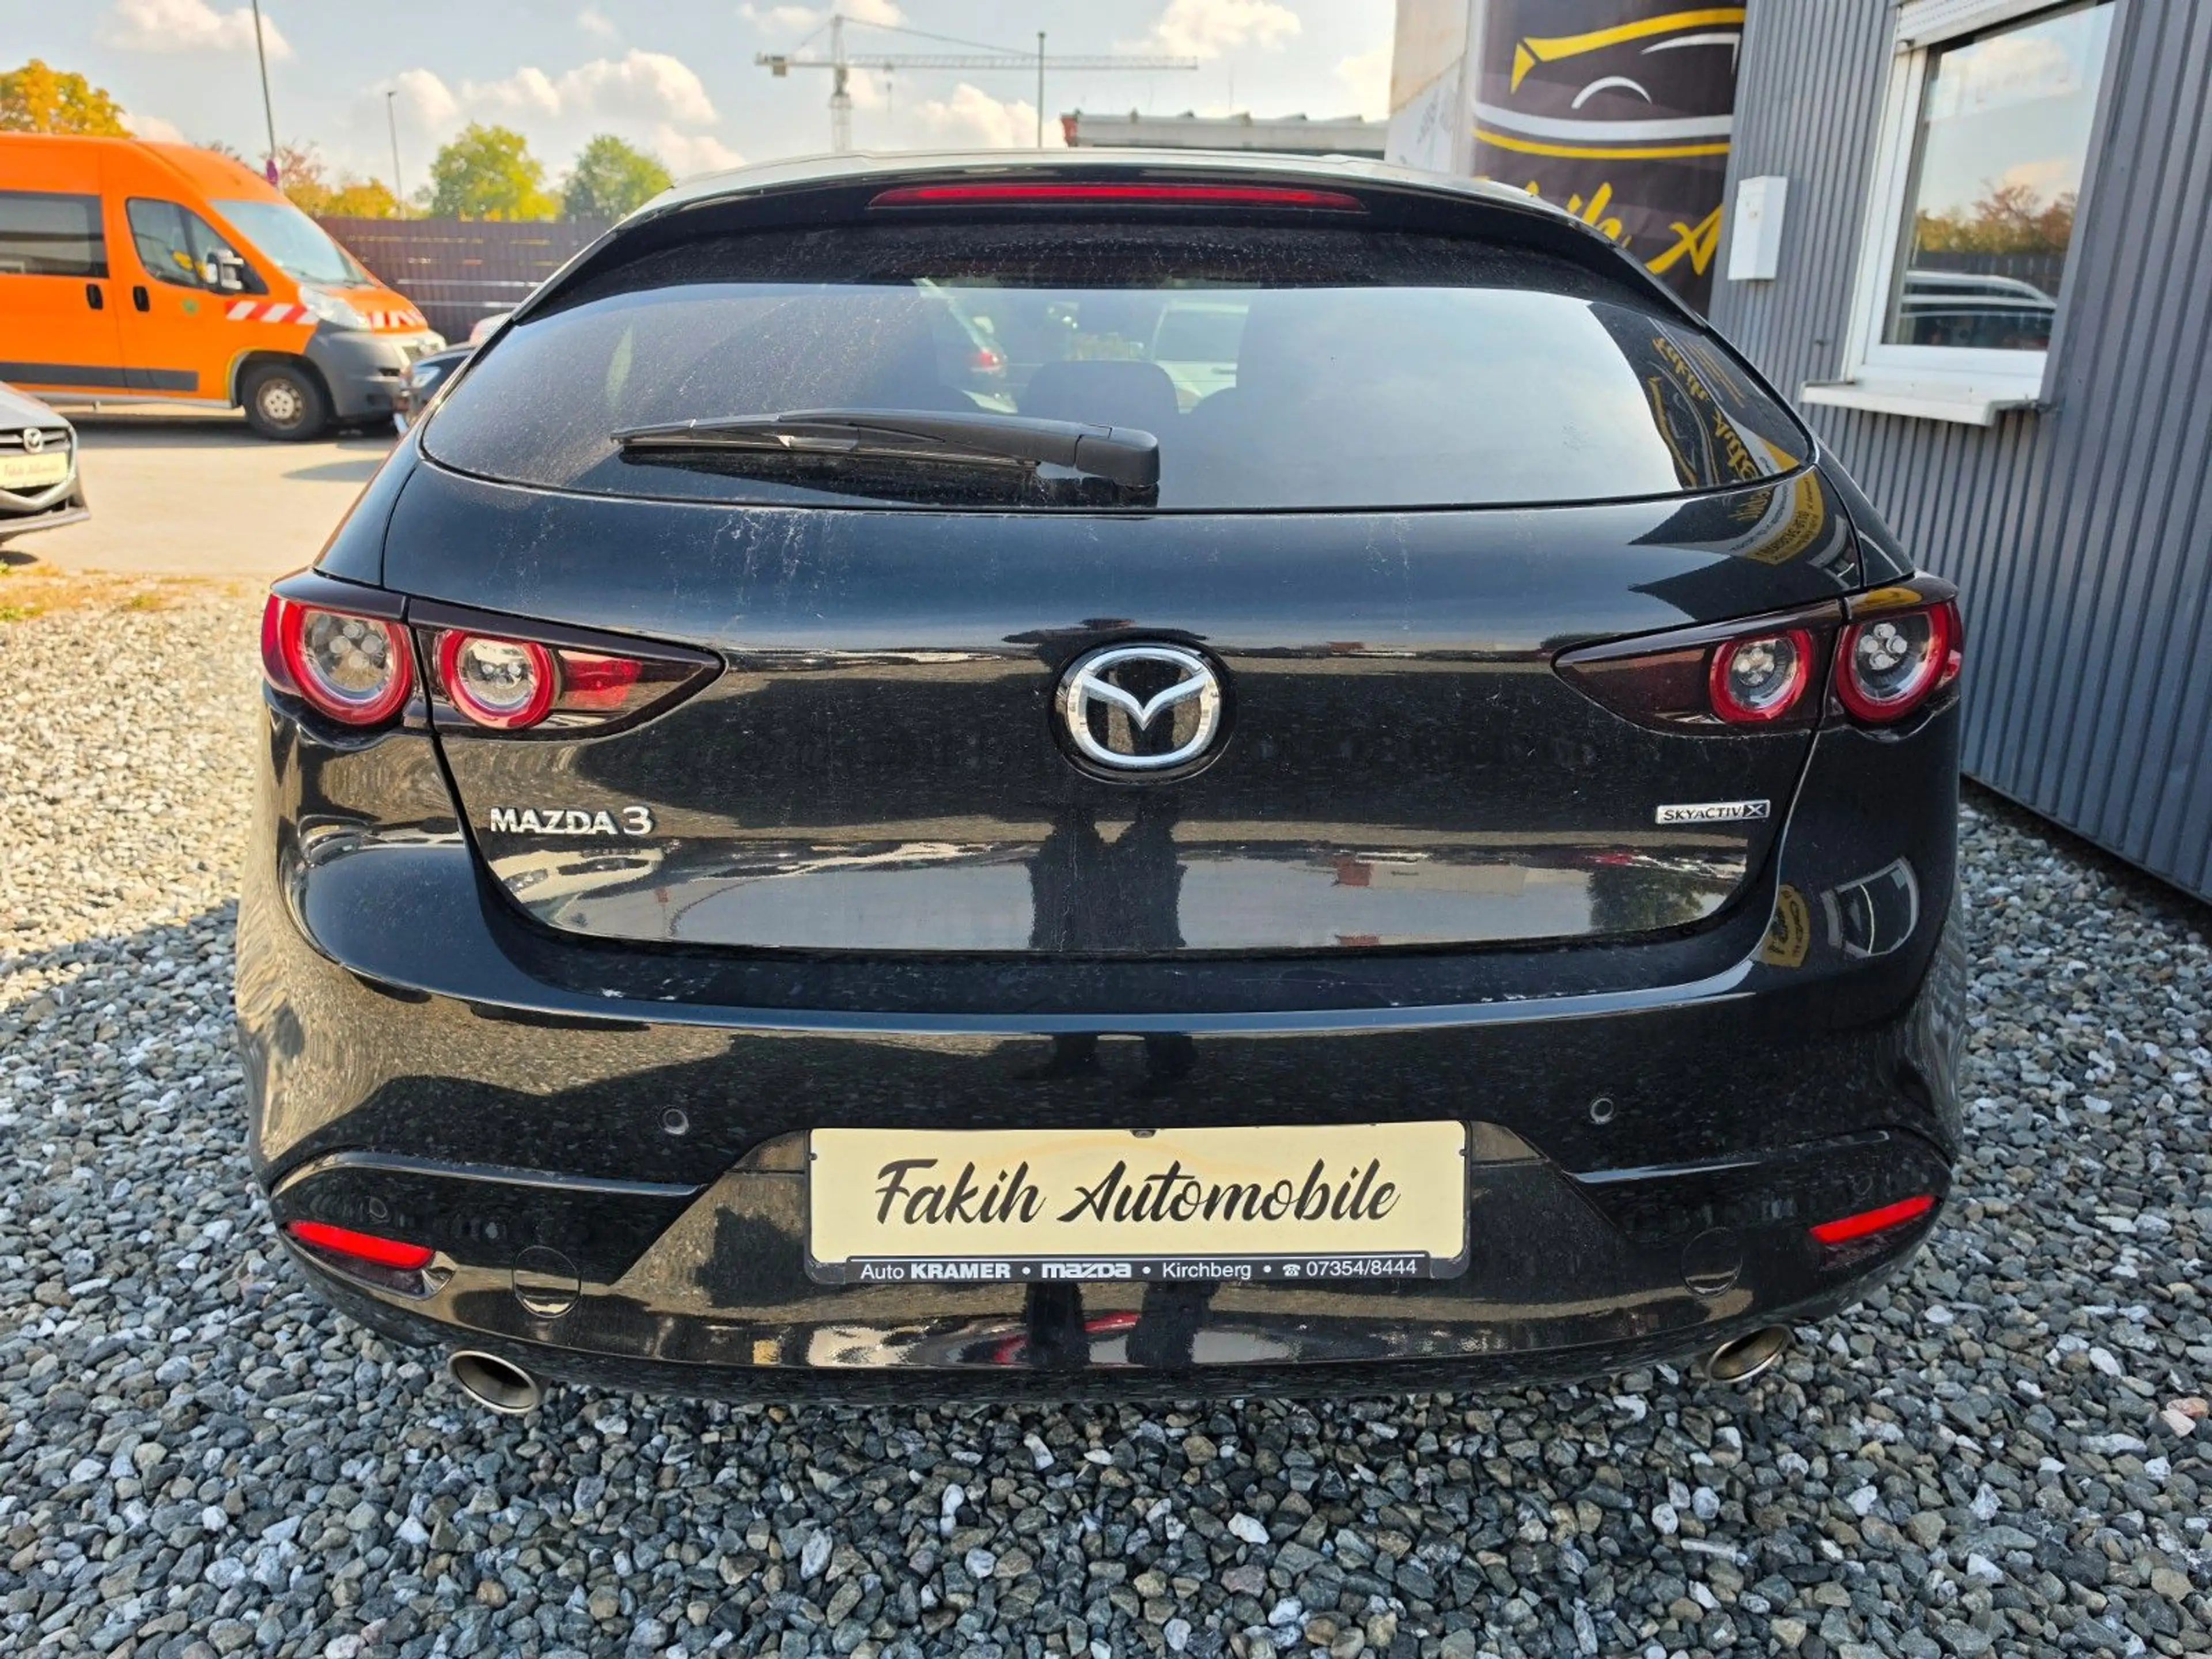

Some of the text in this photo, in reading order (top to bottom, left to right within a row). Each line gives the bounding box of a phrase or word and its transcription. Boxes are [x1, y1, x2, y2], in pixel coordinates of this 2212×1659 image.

[491, 806, 653, 835] MAZDA 3
[875, 1158, 1401, 1225] Fakih Automobile
[861, 1263, 904, 1279] Auto
[911, 1263, 1011, 1279] KRAMER
[1162, 1262, 1252, 1280] Kirchberg
[1306, 1259, 1417, 1277] 07354/8444
